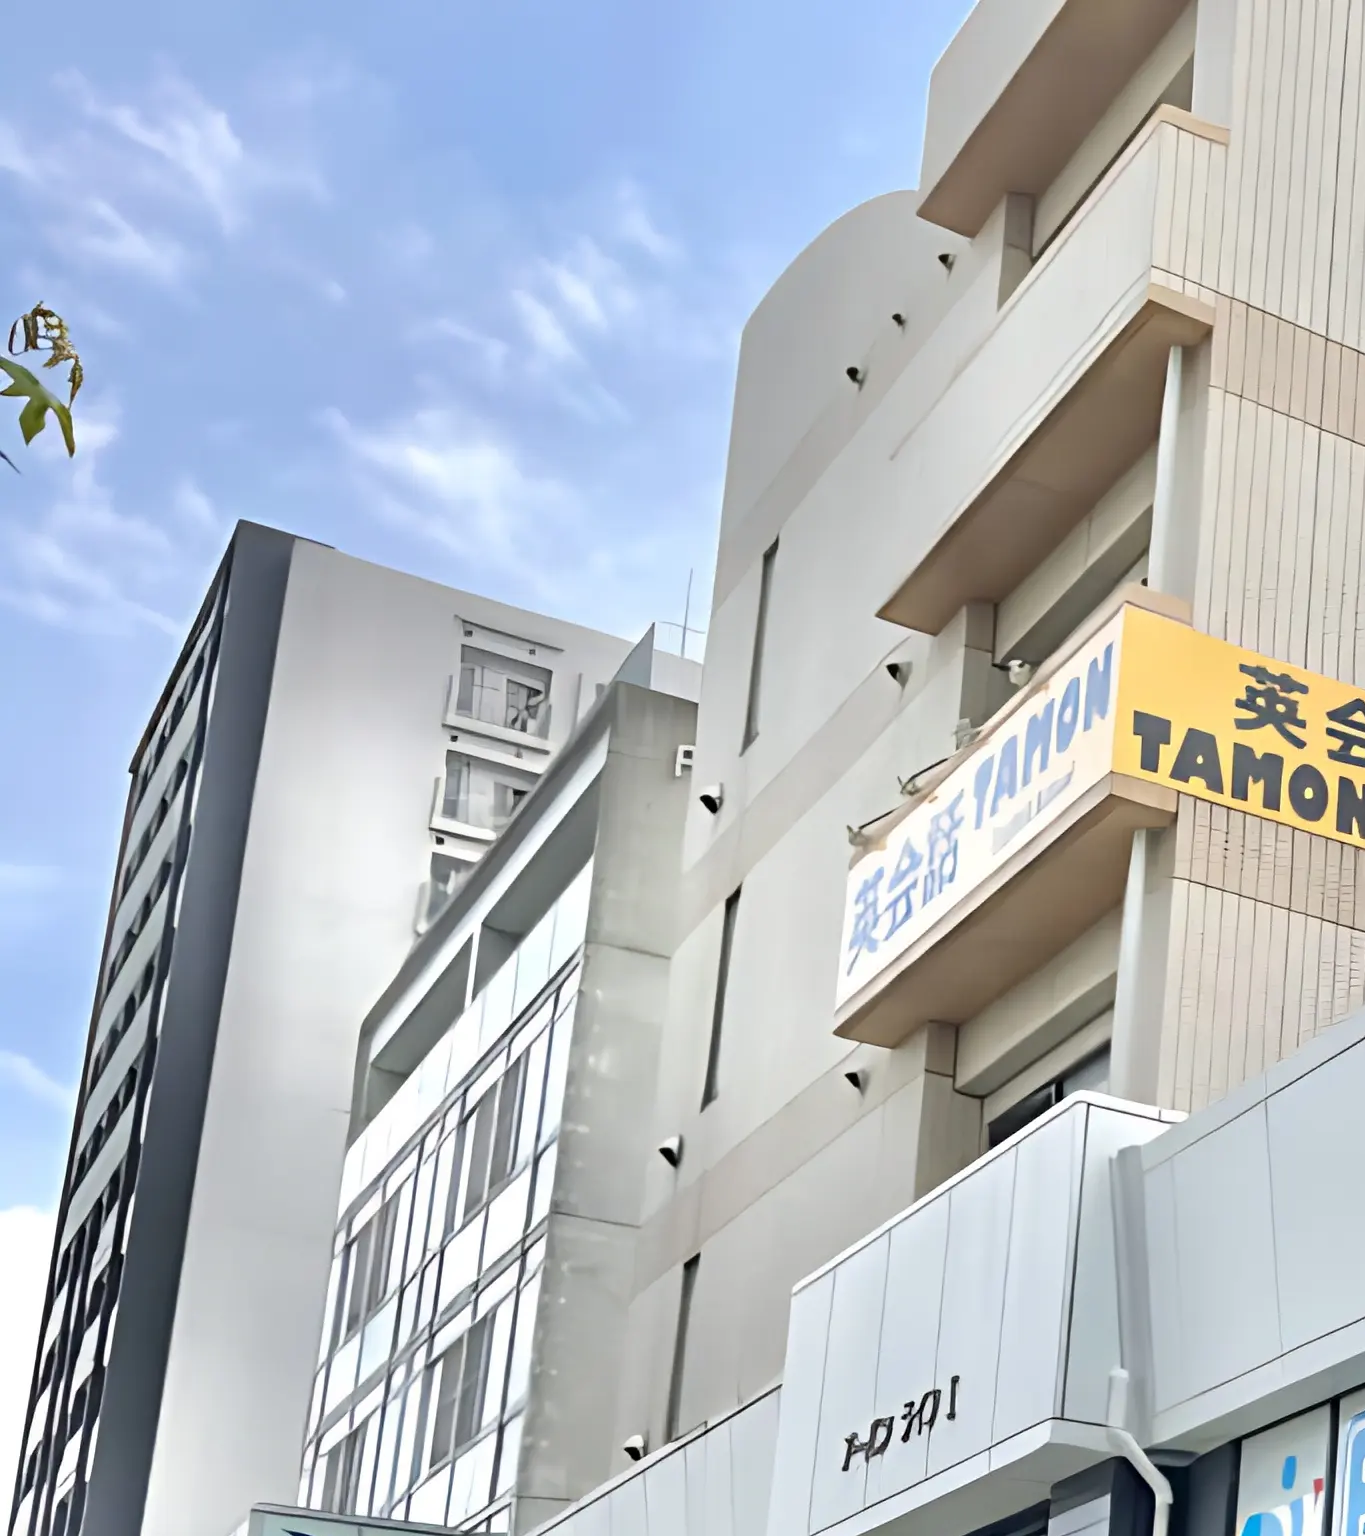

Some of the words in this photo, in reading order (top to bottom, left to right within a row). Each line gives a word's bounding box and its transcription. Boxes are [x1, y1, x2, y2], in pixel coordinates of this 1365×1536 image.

[847, 788, 966, 977] 英会話
[973, 640, 1115, 831] TAMON
